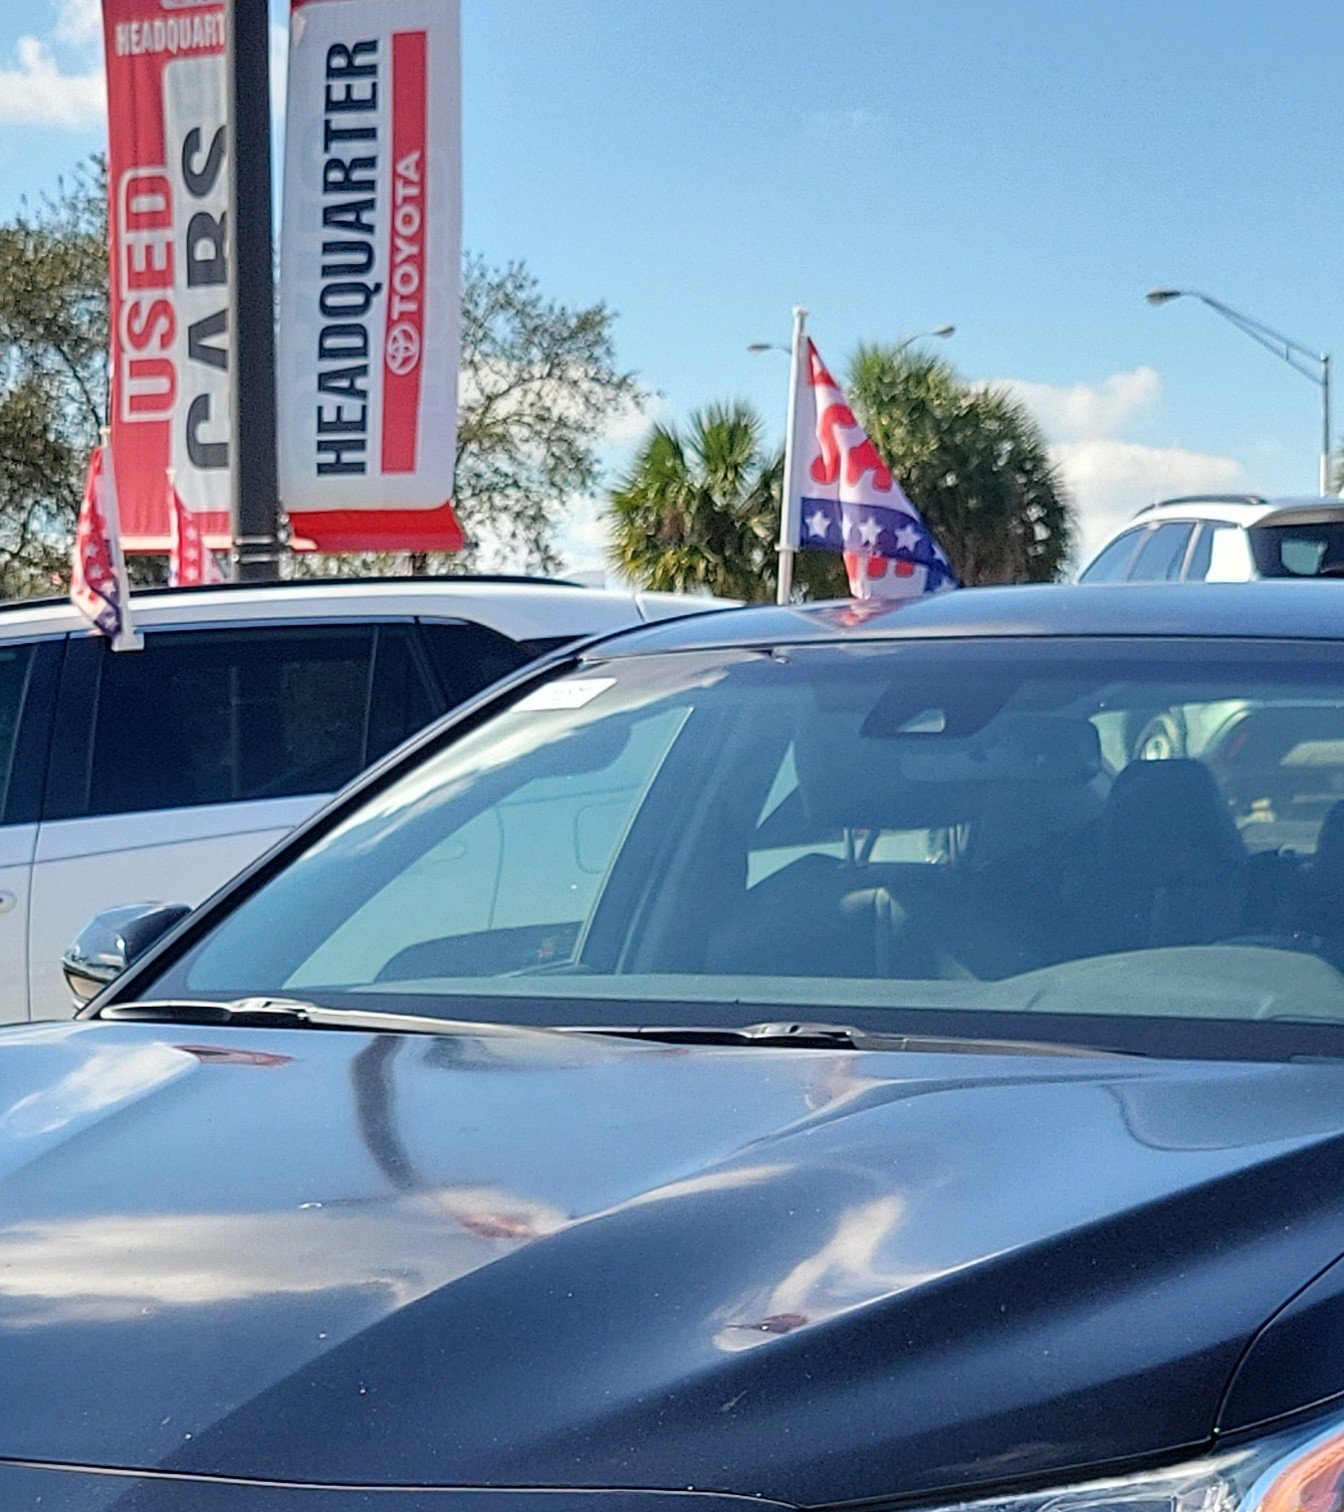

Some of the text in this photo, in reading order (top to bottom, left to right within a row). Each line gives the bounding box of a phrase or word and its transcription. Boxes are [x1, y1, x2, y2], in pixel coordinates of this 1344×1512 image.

[122, 170, 175, 419] USED
[181, 124, 229, 470] CARS
[316, 39, 383, 477] HEADQUARTER
[392, 151, 420, 320] TOYOTA
